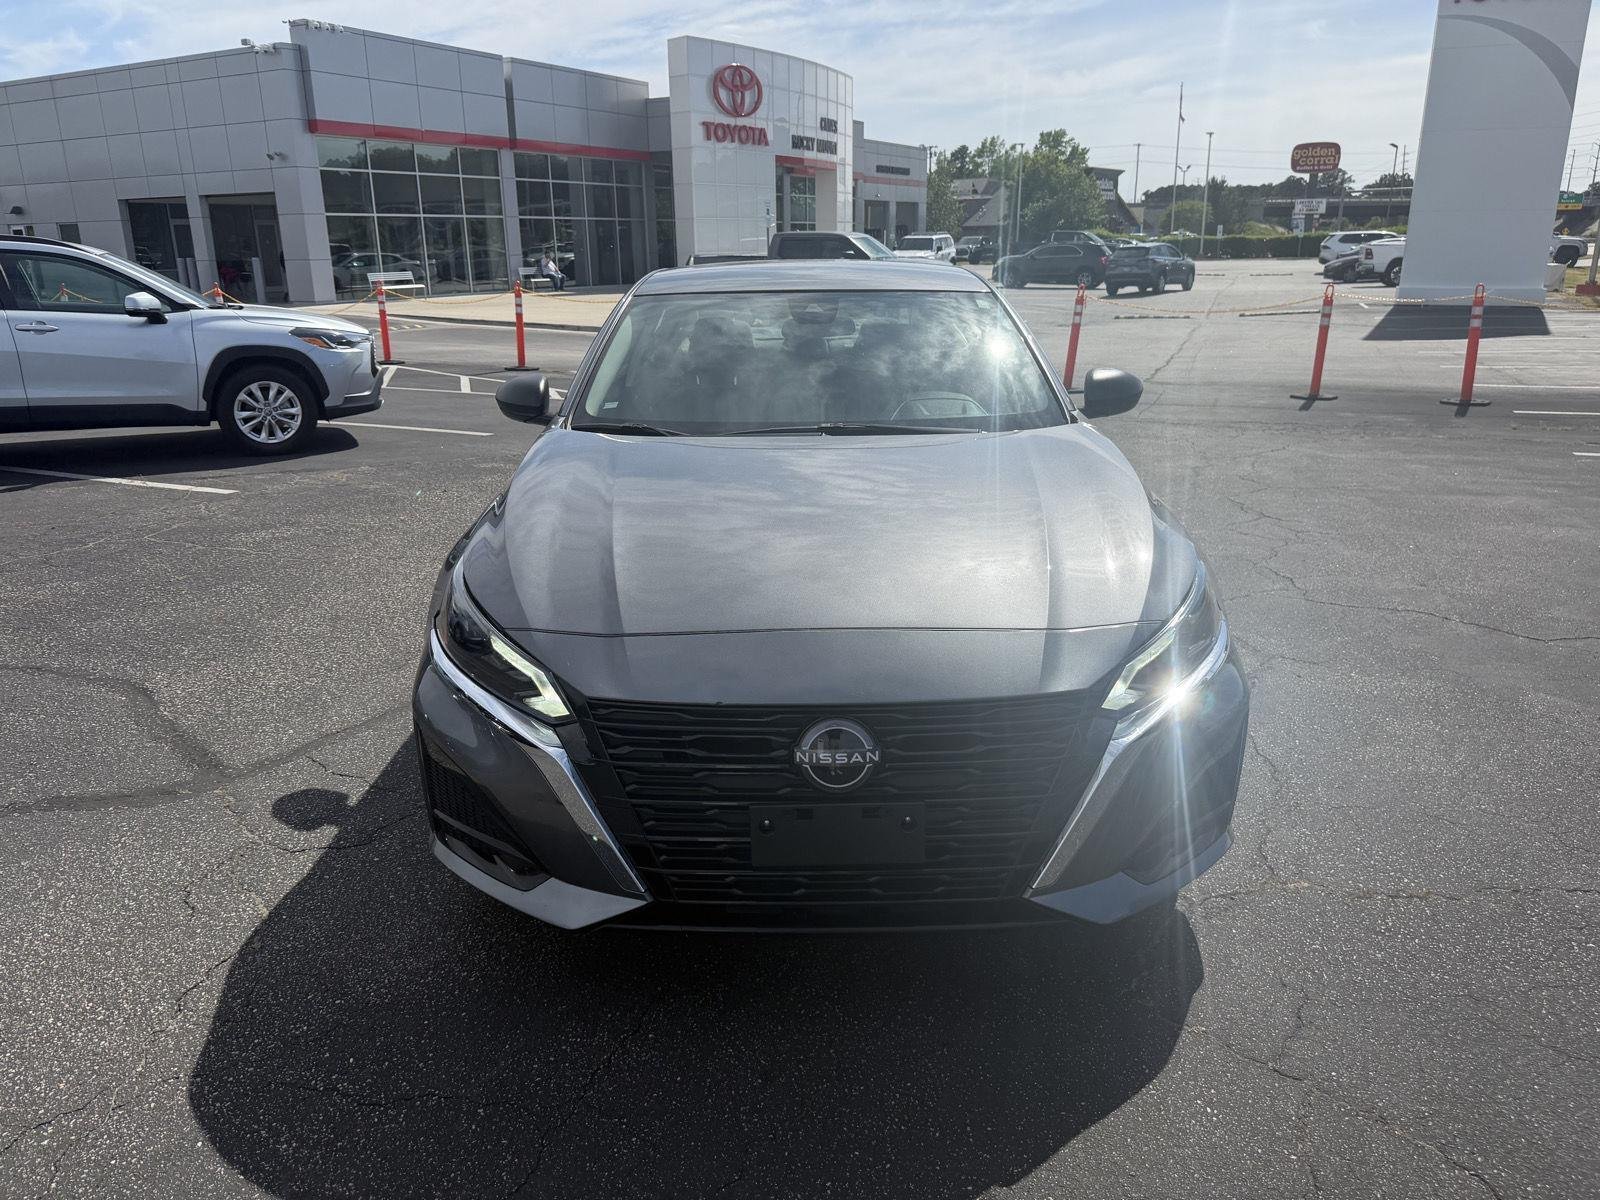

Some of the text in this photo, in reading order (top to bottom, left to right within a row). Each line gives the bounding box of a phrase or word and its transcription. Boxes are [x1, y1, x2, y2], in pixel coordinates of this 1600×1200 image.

[702, 121, 770, 147] TOYOTA
[1293, 147, 1336, 160] golden
[1299, 155, 1339, 165] corral
[796, 751, 879, 764] NISSAN
